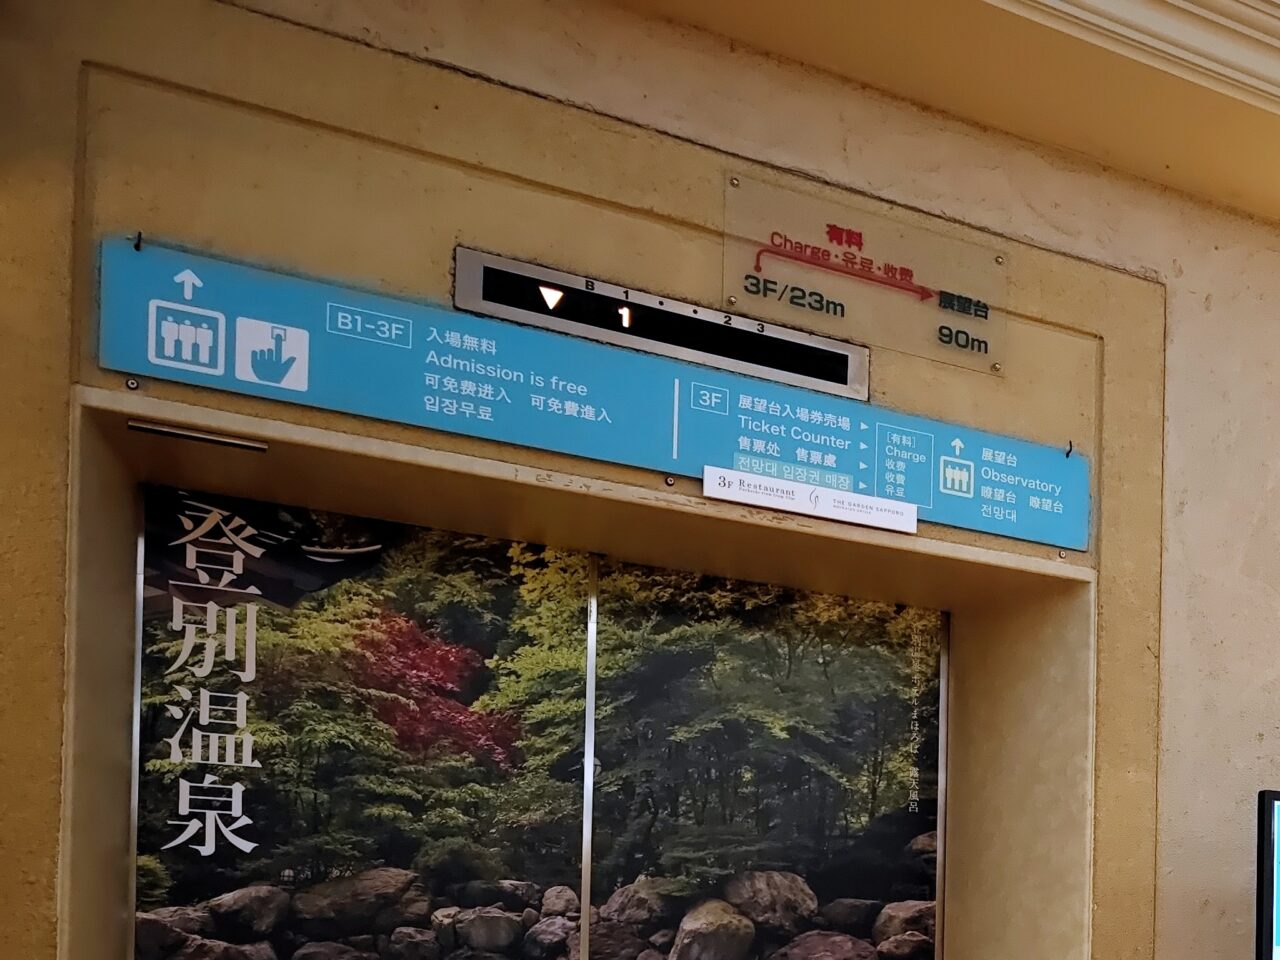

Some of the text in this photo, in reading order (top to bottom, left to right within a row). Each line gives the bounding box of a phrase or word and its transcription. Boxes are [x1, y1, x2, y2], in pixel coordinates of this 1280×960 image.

[826, 224, 863, 251] 有料
[744, 274, 845, 317] 3F/23m
[938, 290, 989, 320] 展望台
[337, 312, 405, 340] B1-3F
[618, 306, 631, 328] 1
[426, 328, 497, 355] 入場無料
[938, 325, 989, 354] 90m
[426, 351, 588, 396] Admission is free
[424, 373, 612, 424] 可免费进入 可免費進入
[424, 396, 495, 422] 입장무료
[699, 390, 722, 407] 3F
[738, 394, 851, 431] 展望台入場券売場
[738, 415, 851, 449] Ticket Counter
[738, 436, 780, 457] 售票处
[886, 446, 927, 463] Charge
[981, 448, 1018, 467] 展望台
[718, 476, 734, 489] 3F
[738, 478, 796, 497] Restaurant
[738, 456, 850, 490] 전망대 입장권 매장
[981, 467, 1062, 496] Observatory
[980, 504, 1017, 523] 전망대
[161, 500, 267, 857] 登別温泉
